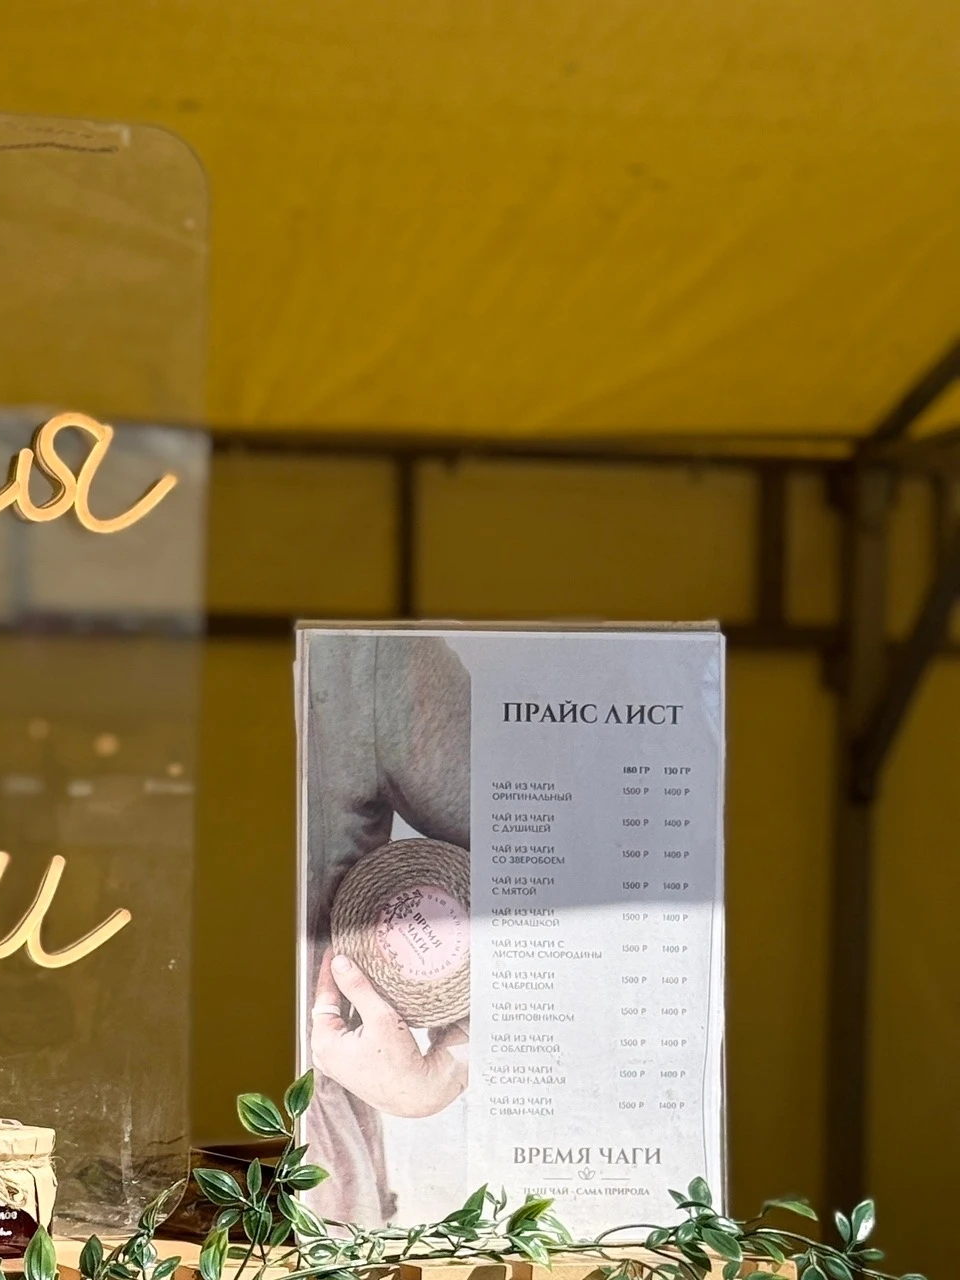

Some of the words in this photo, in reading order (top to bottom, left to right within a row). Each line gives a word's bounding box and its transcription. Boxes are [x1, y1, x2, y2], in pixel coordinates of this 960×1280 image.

[503, 700, 598, 723] ПРАЙС
[604, 704, 684, 725] ЛИСТ
[623, 766, 637, 774] 180
[639, 766, 650, 774] ГР
[664, 767, 678, 775] 130
[680, 767, 691, 775] ГР
[492, 781, 512, 790] ЧАЙ
[492, 792, 572, 801] ОРИГИНАЛЬНЫЙ
[492, 813, 512, 822] ЧАЙ
[514, 814, 528, 822] ИЗ
[530, 814, 555, 822] ЧАГИ
[492, 824, 499, 832] С
[502, 824, 551, 833] ДУШИЦЕЙ
[492, 845, 512, 853] ЧАЙ
[514, 846, 528, 854] ИЗ
[530, 846, 555, 854] ЧАГИ
[492, 856, 507, 864] СО
[509, 856, 565, 864] ЗВЕРОБОЕМ
[492, 876, 512, 885] ЧАЙ
[502, 887, 537, 896] МЯТОЙ
[492, 908, 512, 916] ЧАЙ
[492, 919, 499, 927] С
[502, 919, 560, 927] РОМАШКОЙ
[412, 913, 443, 948] ВРЕМЯ
[408, 923, 430, 954] ЧАГИ
[492, 940, 512, 948] ЧАЙ
[558, 940, 565, 948] С
[492, 951, 535, 959] ЛИСТОМ
[537, 951, 602, 960] СМОРОДИНЫ
[502, 982, 554, 991] ЧАБРЕЦОМ
[501, 1014, 575, 1022] ШИПОВНИКОМ
[501, 1045, 560, 1054] ОБЛЕПИХОЙ
[513, 1147, 591, 1165] ВРЕМЯ
[600, 1148, 662, 1165] ЧАГИ
[605, 1188, 650, 1196] ПРИРОДА
